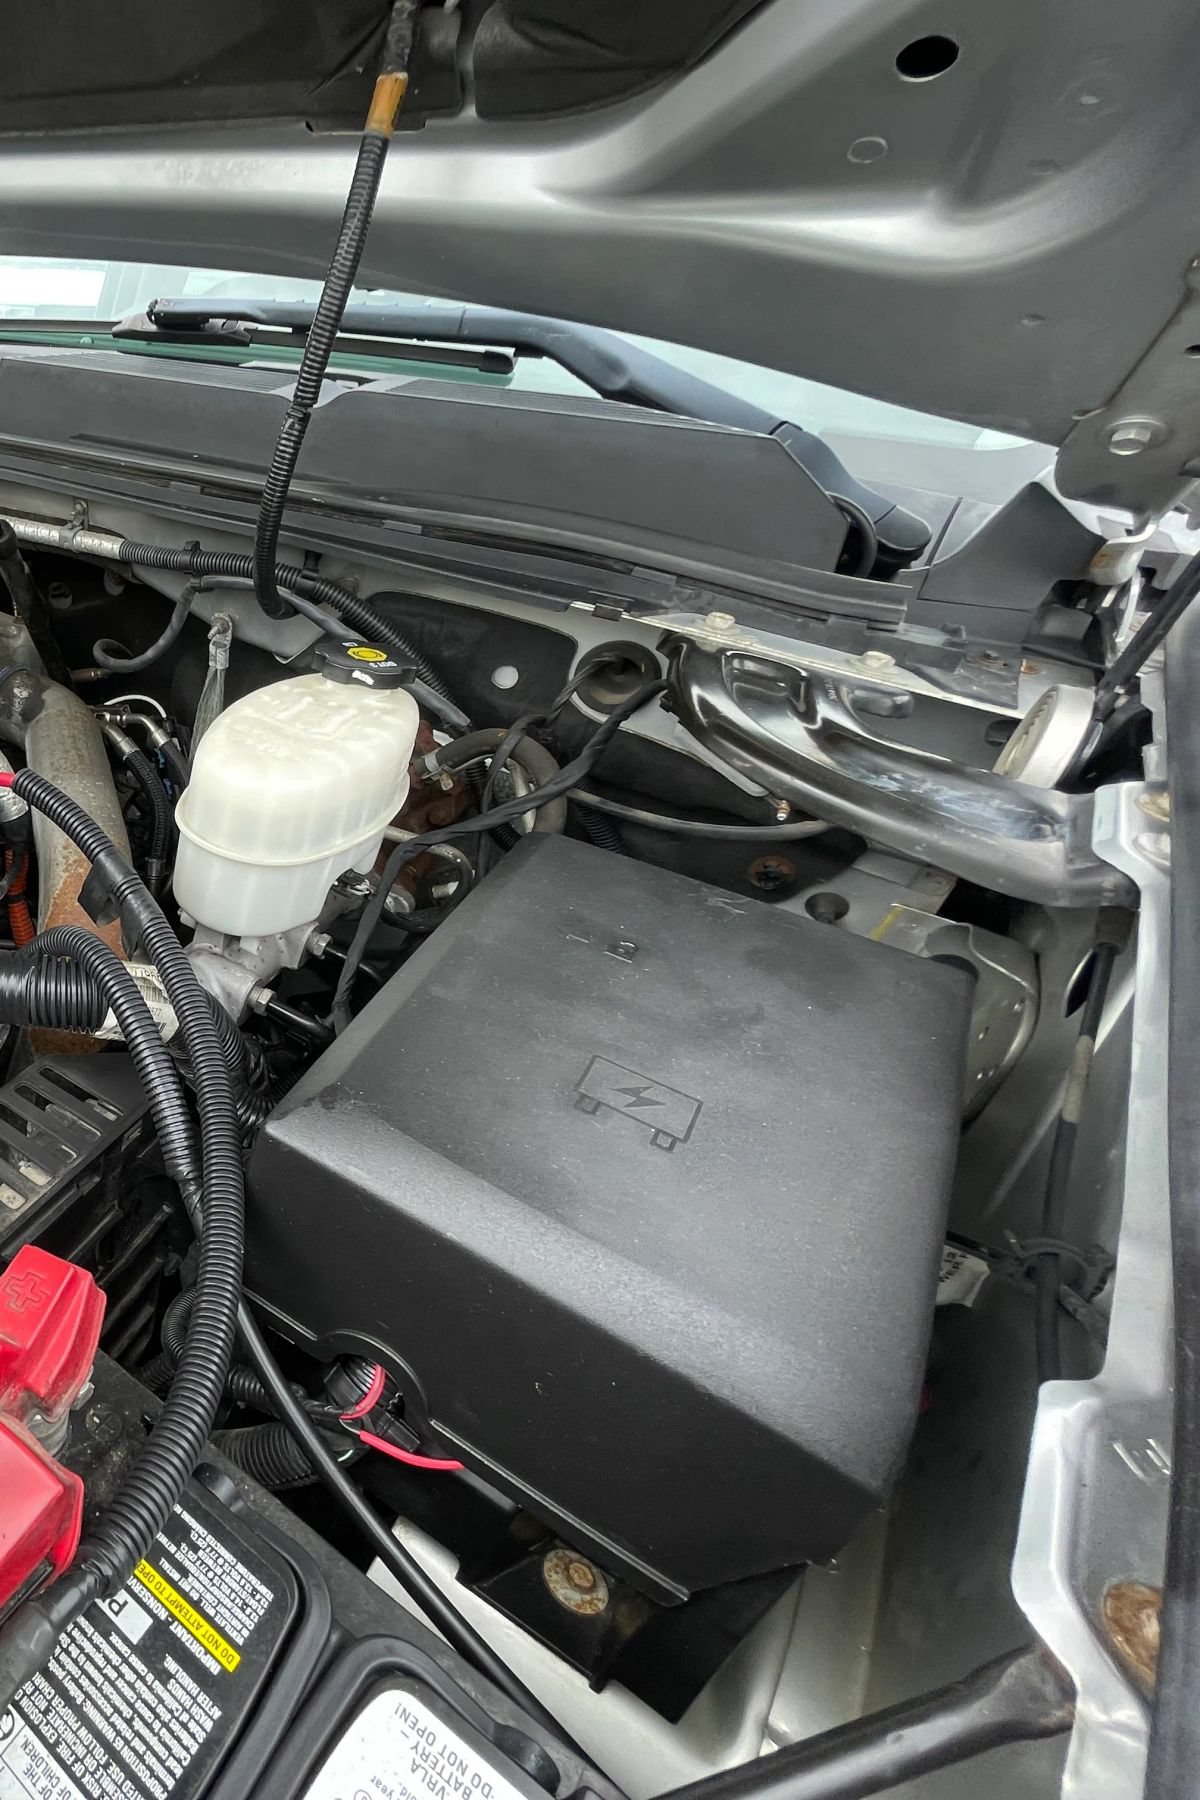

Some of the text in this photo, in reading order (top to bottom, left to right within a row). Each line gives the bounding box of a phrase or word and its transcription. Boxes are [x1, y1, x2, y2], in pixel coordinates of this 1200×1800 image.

[180, 1510, 207, 1537] CHARGING
[205, 1533, 236, 1565] CORRECTED
[157, 1556, 180, 1581] INSTALL
[197, 1548, 264, 1615] FLOAT/STANDBY BETWEEN
[222, 1561, 241, 1582] VOLTS
[234, 1561, 274, 1601] TEMPERATURE
[154, 1580, 166, 1594] TO
[178, 1577, 191, 1592] NOT
[189, 1588, 200, 1600] DO
[212, 1575, 232, 1595] VOLTS
[165, 1591, 203, 1631] ATTEMPT
[215, 1602, 243, 1631] AIRTIGHT
[201, 1627, 221, 1650] NOT
[213, 1612, 245, 1646] VENTILATE
[240, 1626, 250, 1638] IN
[67, 1642, 80, 1658] the
[71, 1627, 108, 1668] reproductive
[77, 1653, 85, 1665] to
[91, 1630, 121, 1667] chemicals
[170, 1619, 221, 1675] IMPORTANT
[220, 1647, 235, 1664] DO
[83, 1659, 103, 1686] known
[103, 1663, 118, 1681] and
[119, 1661, 136, 1683] other
[161, 1653, 222, 1720] AFTER HANDLING.
[31, 1690, 47, 1710] NOT
[63, 1674, 85, 1704] Battery
[100, 1680, 133, 1720] chemicals
[108, 1631, 206, 1743] State of California to cause cancer.
[115, 1676, 137, 1703] cancer
[133, 1678, 158, 1707] contain
[19, 1695, 57, 1743] EXPLOSION
[51, 1693, 80, 1730] PROPER
[134, 1698, 154, 1723] cause
[155, 1703, 171, 1723] also
[166, 1677, 215, 1732] WASH HANDS
[44, 1705, 86, 1758] INCINERATE.
[58, 1651, 175, 1790] terminals and related accessories contain
[81, 1697, 117, 1742] WARNING:
[151, 1718, 161, 1732] to
[54, 1736, 75, 1764] FIRE,
[77, 1725, 108, 1764] FOLLOW
[112, 1735, 124, 1751] 65
[129, 1713, 168, 1759] compounds,
[158, 1726, 191, 1767] California
[168, 1718, 199, 1754] Batteries
[393, 1701, 493, 1798] DO NOT OPEN!
[21, 1734, 60, 1789] CHILDREN.
[23, 1763, 40, 1788] THE
[72, 1759, 85, 1776] OF
[82, 1752, 97, 1771] OR
[104, 1758, 125, 1785] USE.
[120, 1744, 167, 1800] PROPOSITION
[164, 1755, 183, 1779] lead
[410, 1738, 472, 1800] BATTERY
[81, 1771, 102, 1797] RISK
[407, 1757, 448, 1799] VRLA
